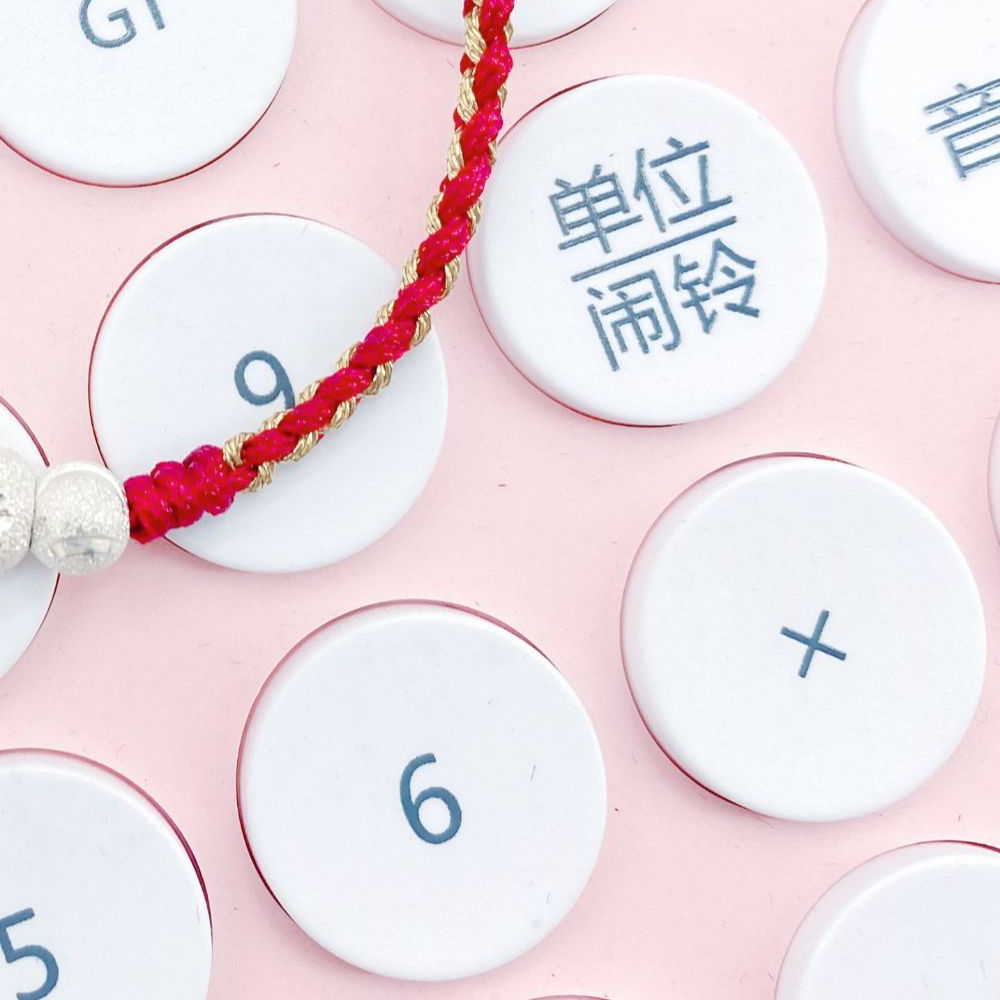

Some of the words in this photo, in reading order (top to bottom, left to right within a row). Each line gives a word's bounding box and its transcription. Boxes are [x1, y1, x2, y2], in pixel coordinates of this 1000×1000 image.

[547, 136, 733, 255] 单位
[586, 239, 760, 372] 闹铃
[234, 350, 296, 410] 9
[398, 753, 463, 845] 6
